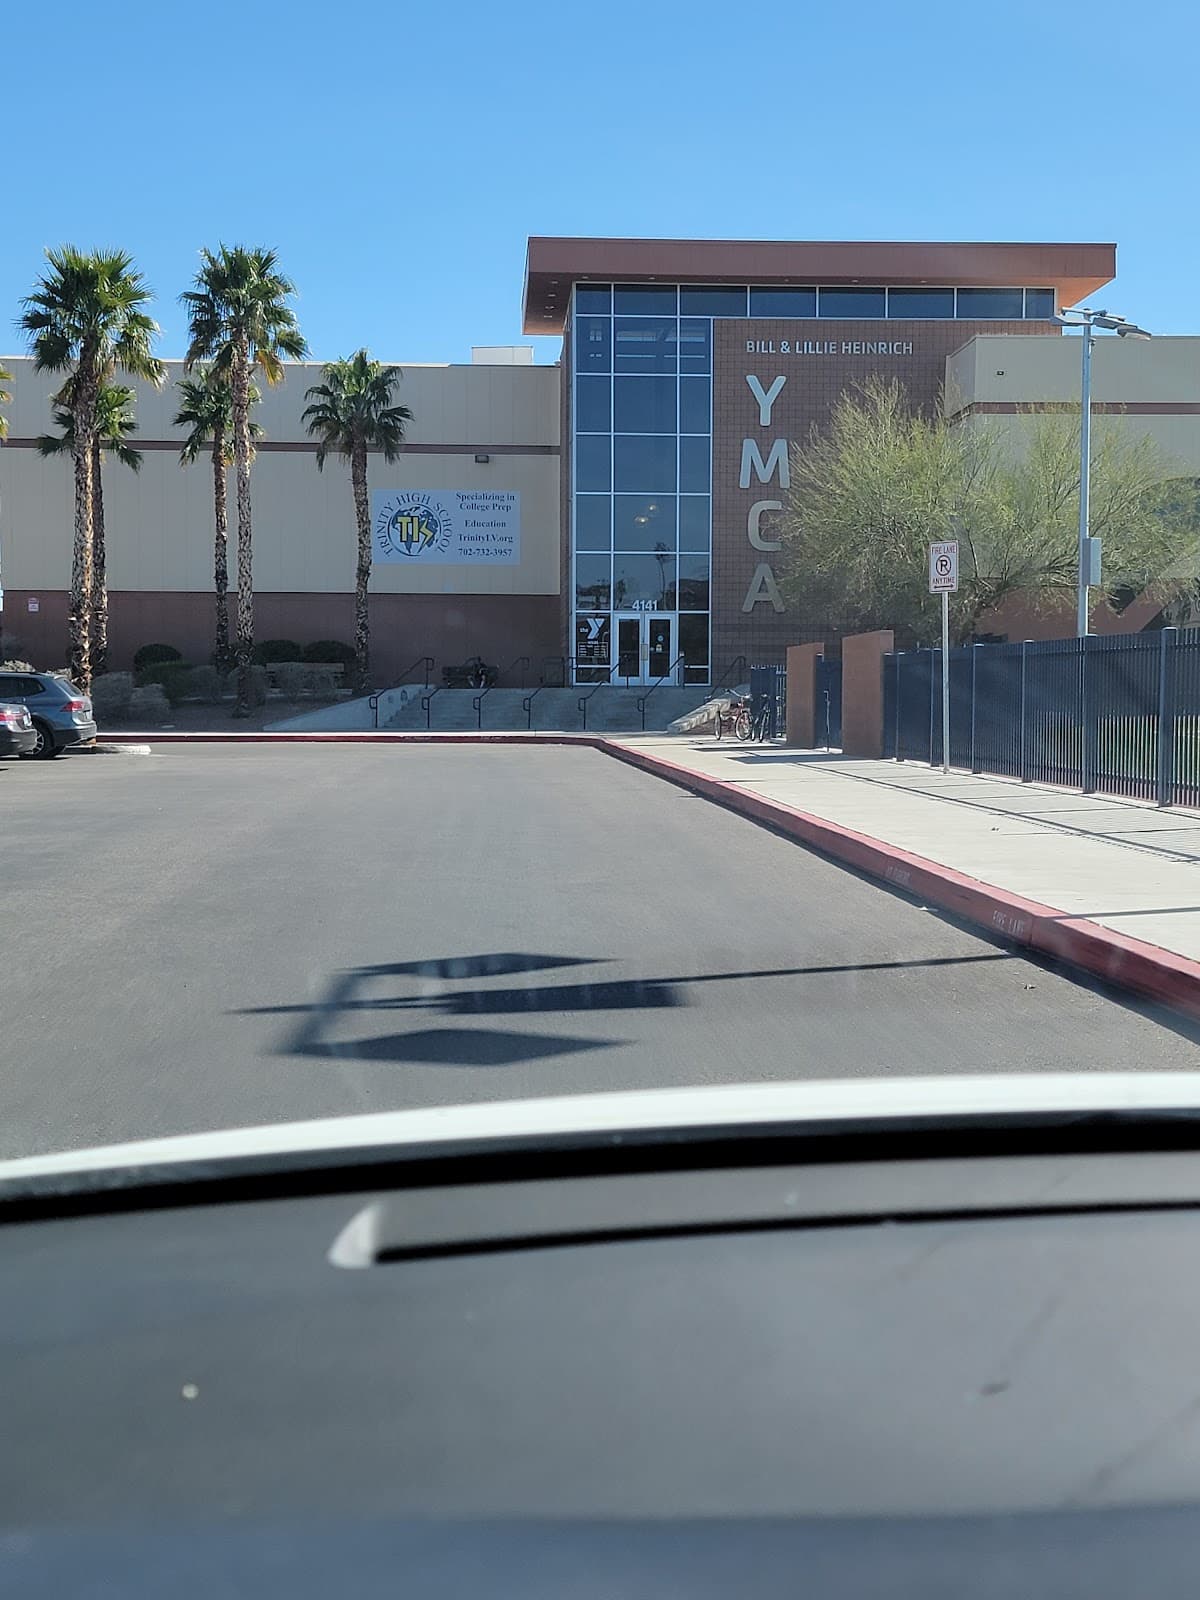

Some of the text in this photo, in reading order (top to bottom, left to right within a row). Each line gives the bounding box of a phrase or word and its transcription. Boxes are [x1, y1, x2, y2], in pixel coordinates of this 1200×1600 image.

[746, 340, 913, 355] BILL & LILLIE HEINRICH
[456, 492, 515, 502] Specializing in
[459, 502, 512, 512] College Prep
[376, 492, 453, 556] TRINITY HIGH SCHOOL
[464, 519, 506, 528] Education
[458, 533, 514, 544] TrinityLV.org
[457, 548, 513, 557] 702-732-3957
[632, 599, 658, 611] 4141
